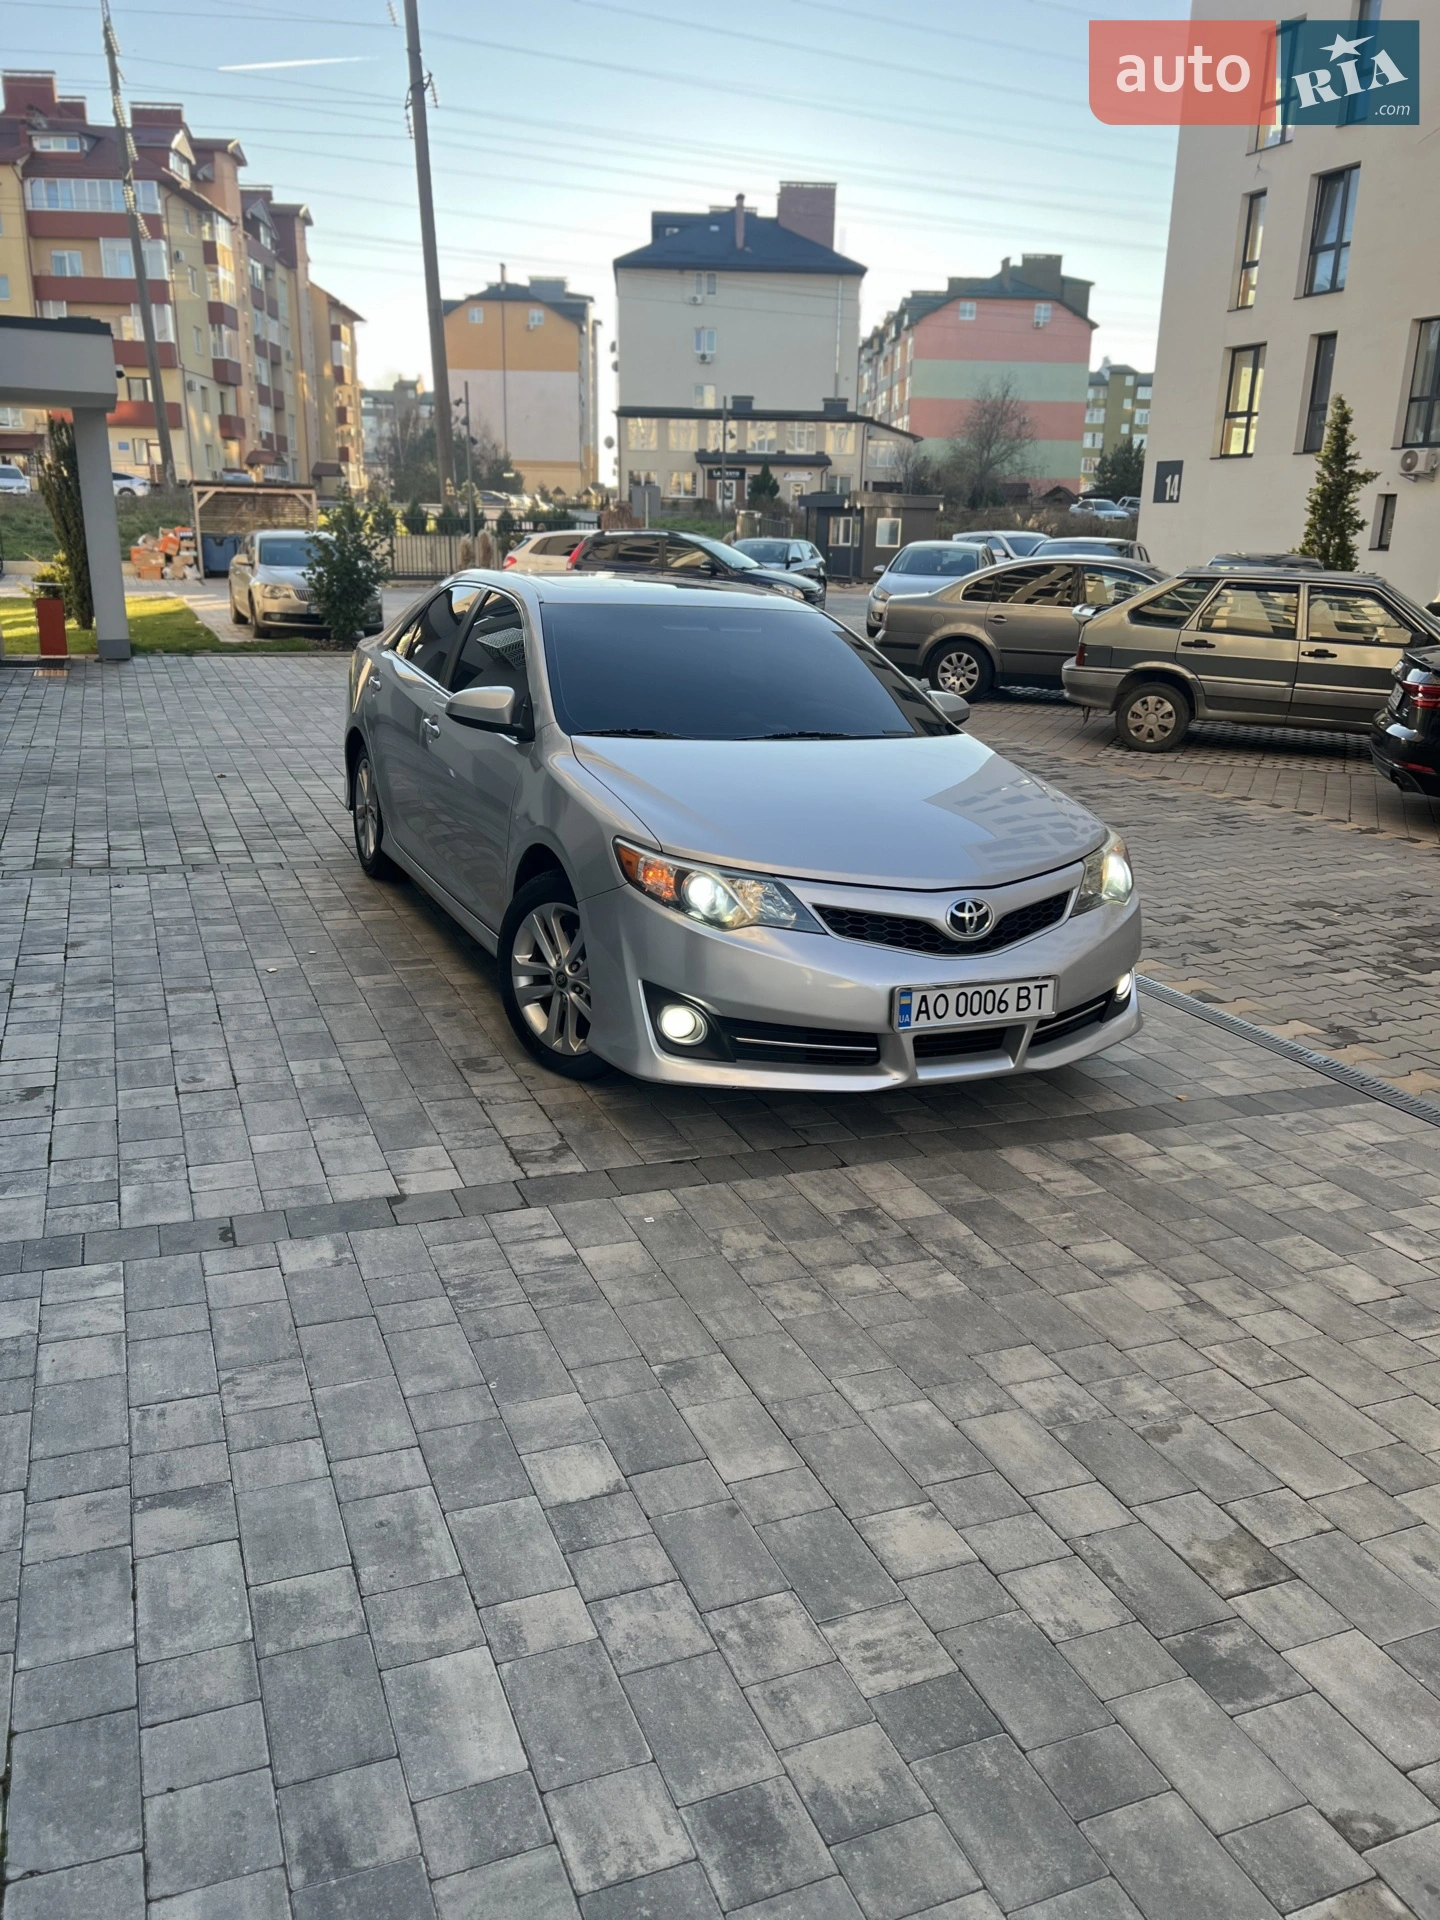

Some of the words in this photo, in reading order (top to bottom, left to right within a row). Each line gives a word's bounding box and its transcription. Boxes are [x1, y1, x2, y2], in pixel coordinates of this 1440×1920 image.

[1165, 474, 1180, 501] 14
[915, 993, 949, 1022] AO
[955, 987, 1010, 1018] 0006
[1016, 984, 1049, 1012] BT
[898, 1014, 910, 1024] UA
